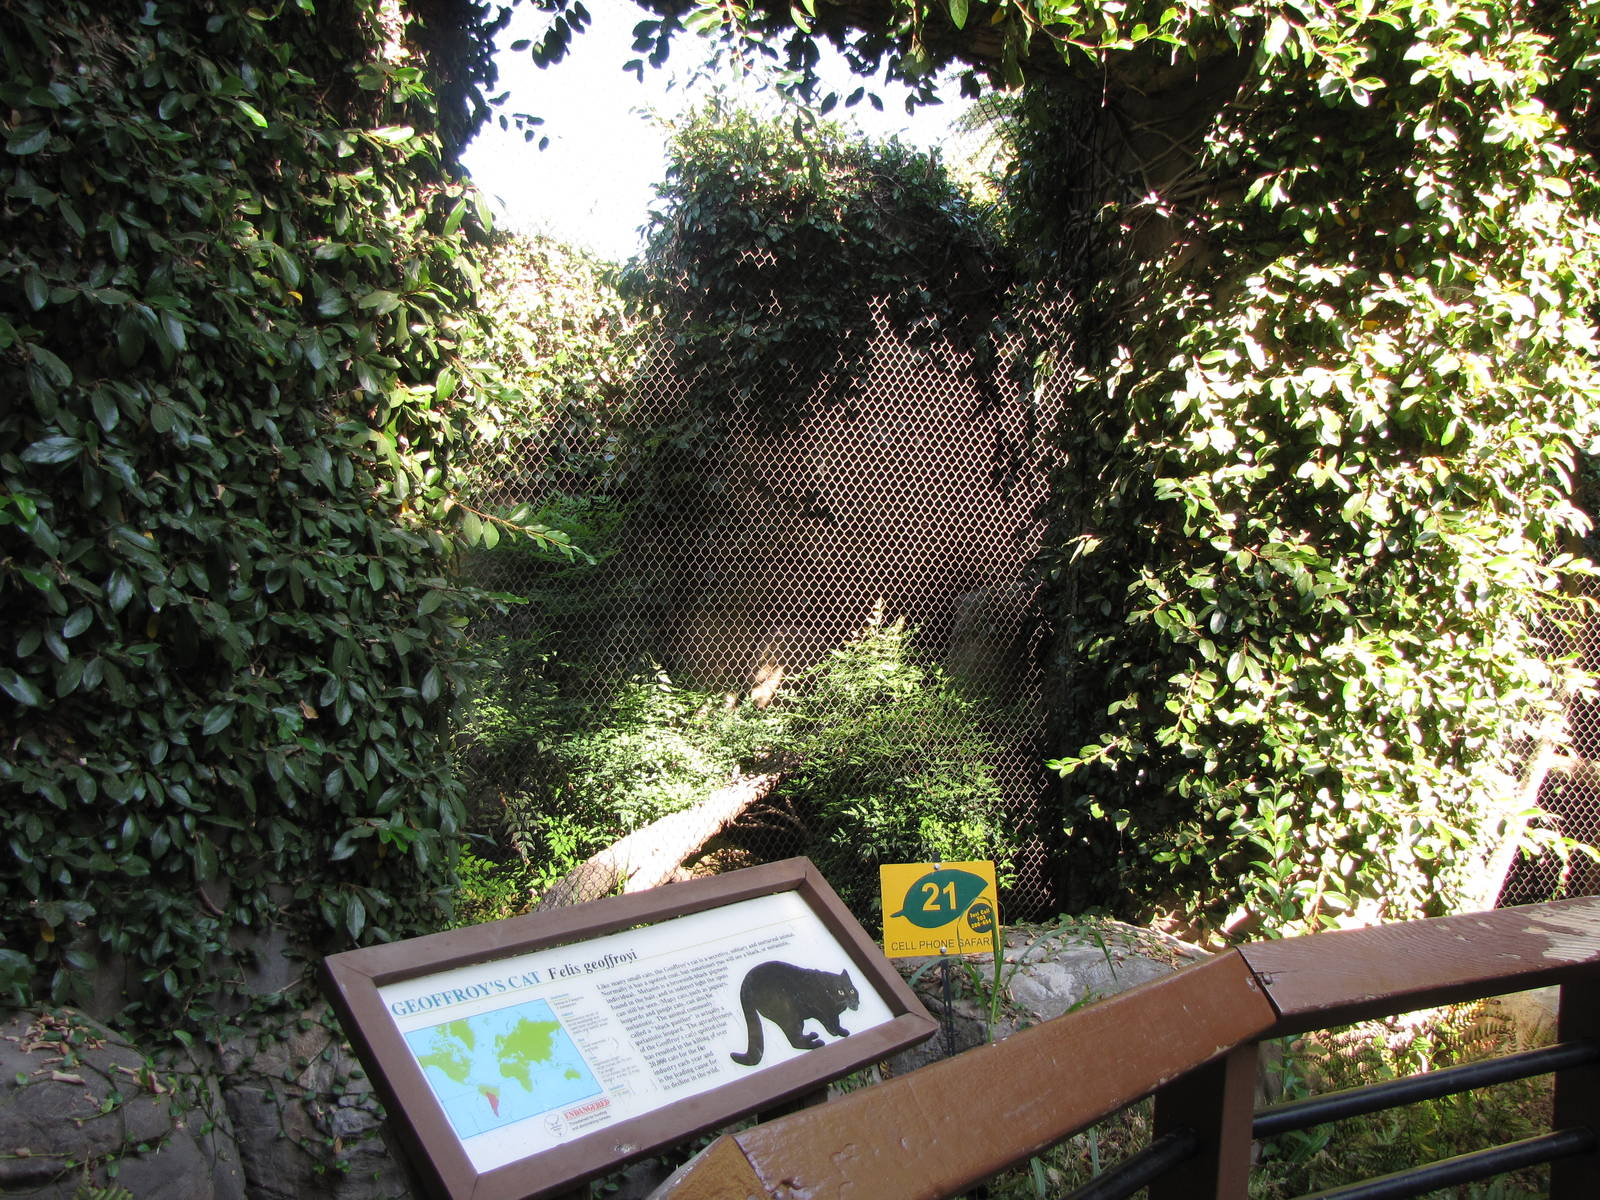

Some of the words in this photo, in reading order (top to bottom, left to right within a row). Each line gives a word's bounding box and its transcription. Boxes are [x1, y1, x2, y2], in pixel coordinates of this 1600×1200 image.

[921, 881, 957, 911] 21
[891, 941, 916, 951] CELL
[920, 938, 955, 950] PHONE
[391, 977, 507, 1017] GEOFFROY'S
[508, 971, 543, 990] CAT
[548, 963, 581, 981] Felis
[583, 948, 638, 975] geoffroyi
[565, 1100, 610, 1120] ENDANGERED
